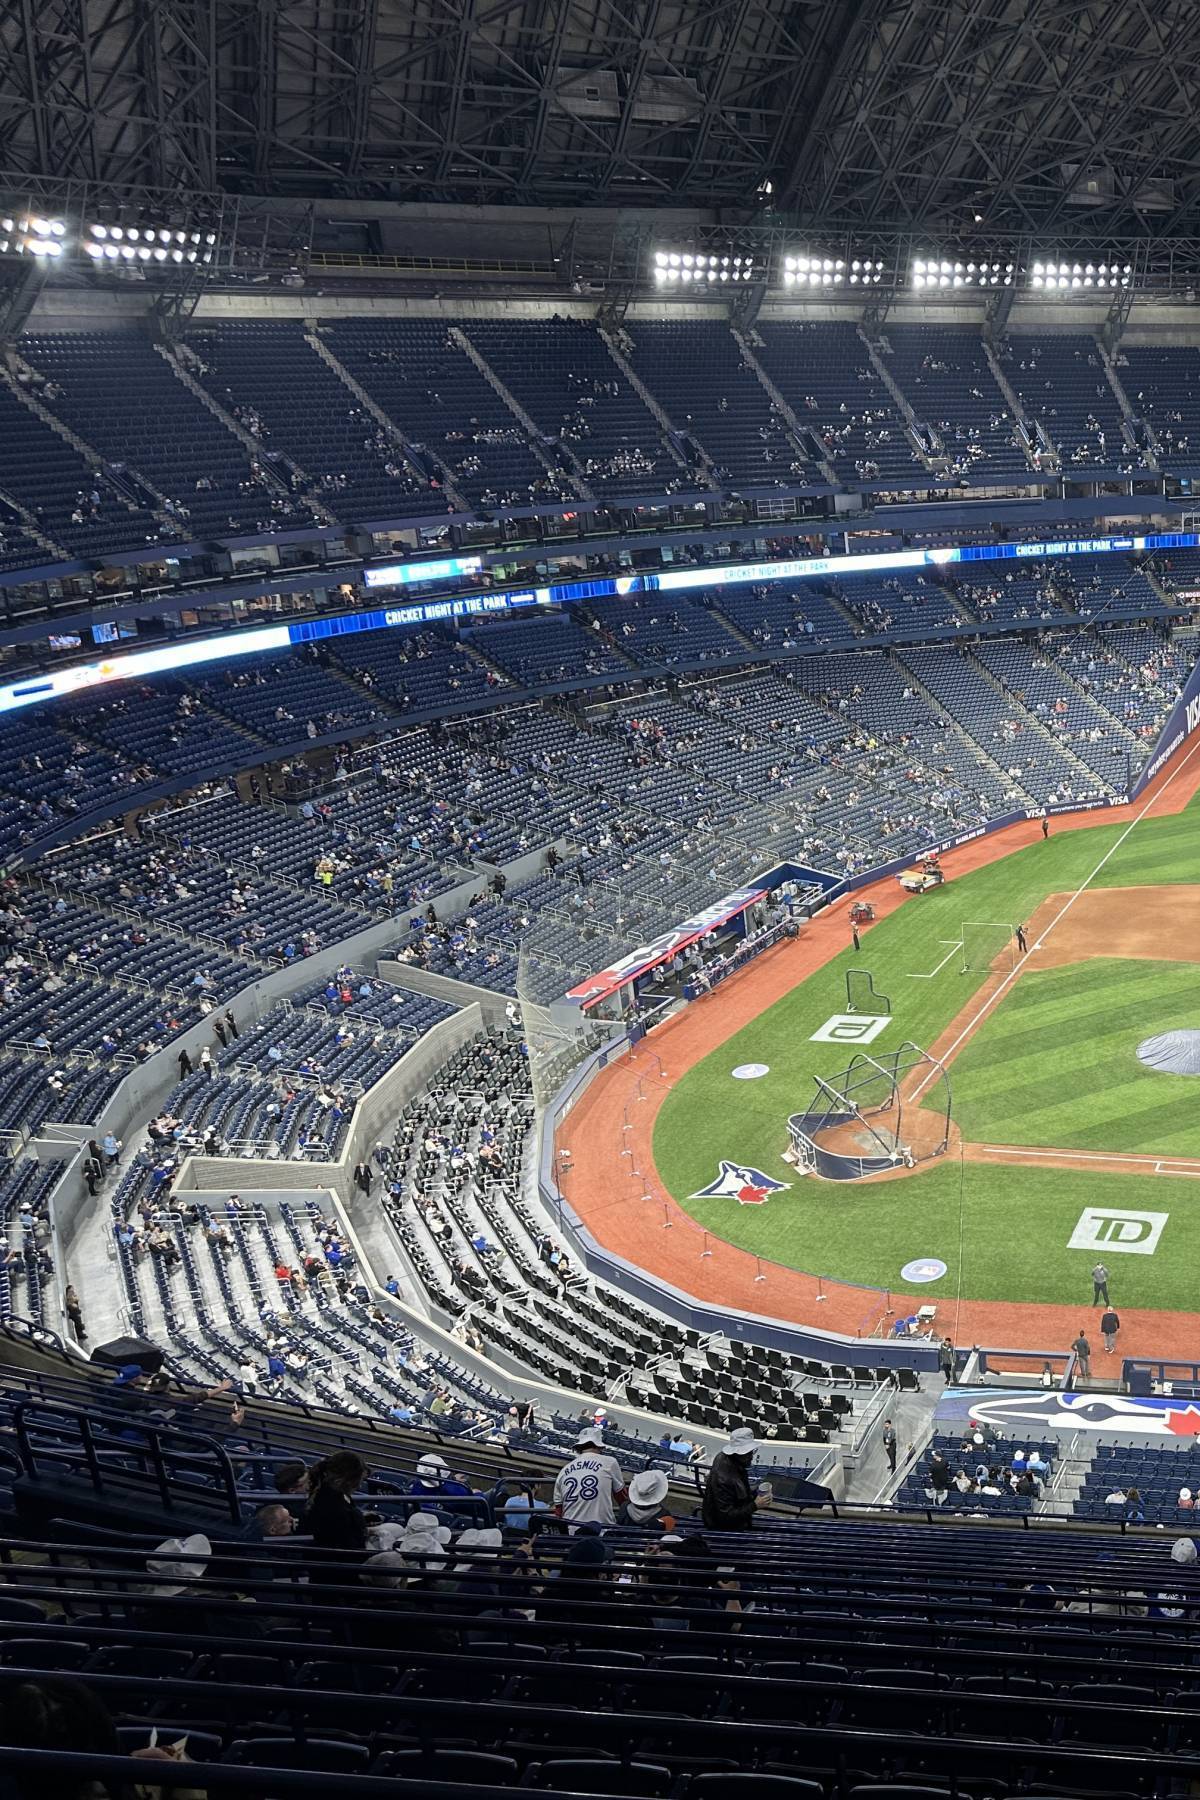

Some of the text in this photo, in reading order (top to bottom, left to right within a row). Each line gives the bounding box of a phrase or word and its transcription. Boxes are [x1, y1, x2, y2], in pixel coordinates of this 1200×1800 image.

[1016, 544, 1045, 556] CRICKET
[1046, 543, 1067, 554] NIGHT
[1068, 542, 1078, 552] AT
[1079, 541, 1092, 552] THE
[1093, 541, 1111, 551] PARK
[724, 567, 756, 579] CRICKET
[758, 565, 780, 577] NIGHT
[810, 562, 829, 572] PARK
[385, 607, 424, 625] CRICKET
[424, 602, 452, 620] NIGHT
[453, 600, 464, 616] AT
[466, 598, 483, 613] THE
[484, 595, 508, 611] PARK
[1025, 808, 1047, 819] VISA
[1108, 795, 1129, 806] VISA
[1090, 1216, 1152, 1243] TD
[564, 1460, 602, 1476] RASMUS
[563, 1474, 599, 1501] 28
